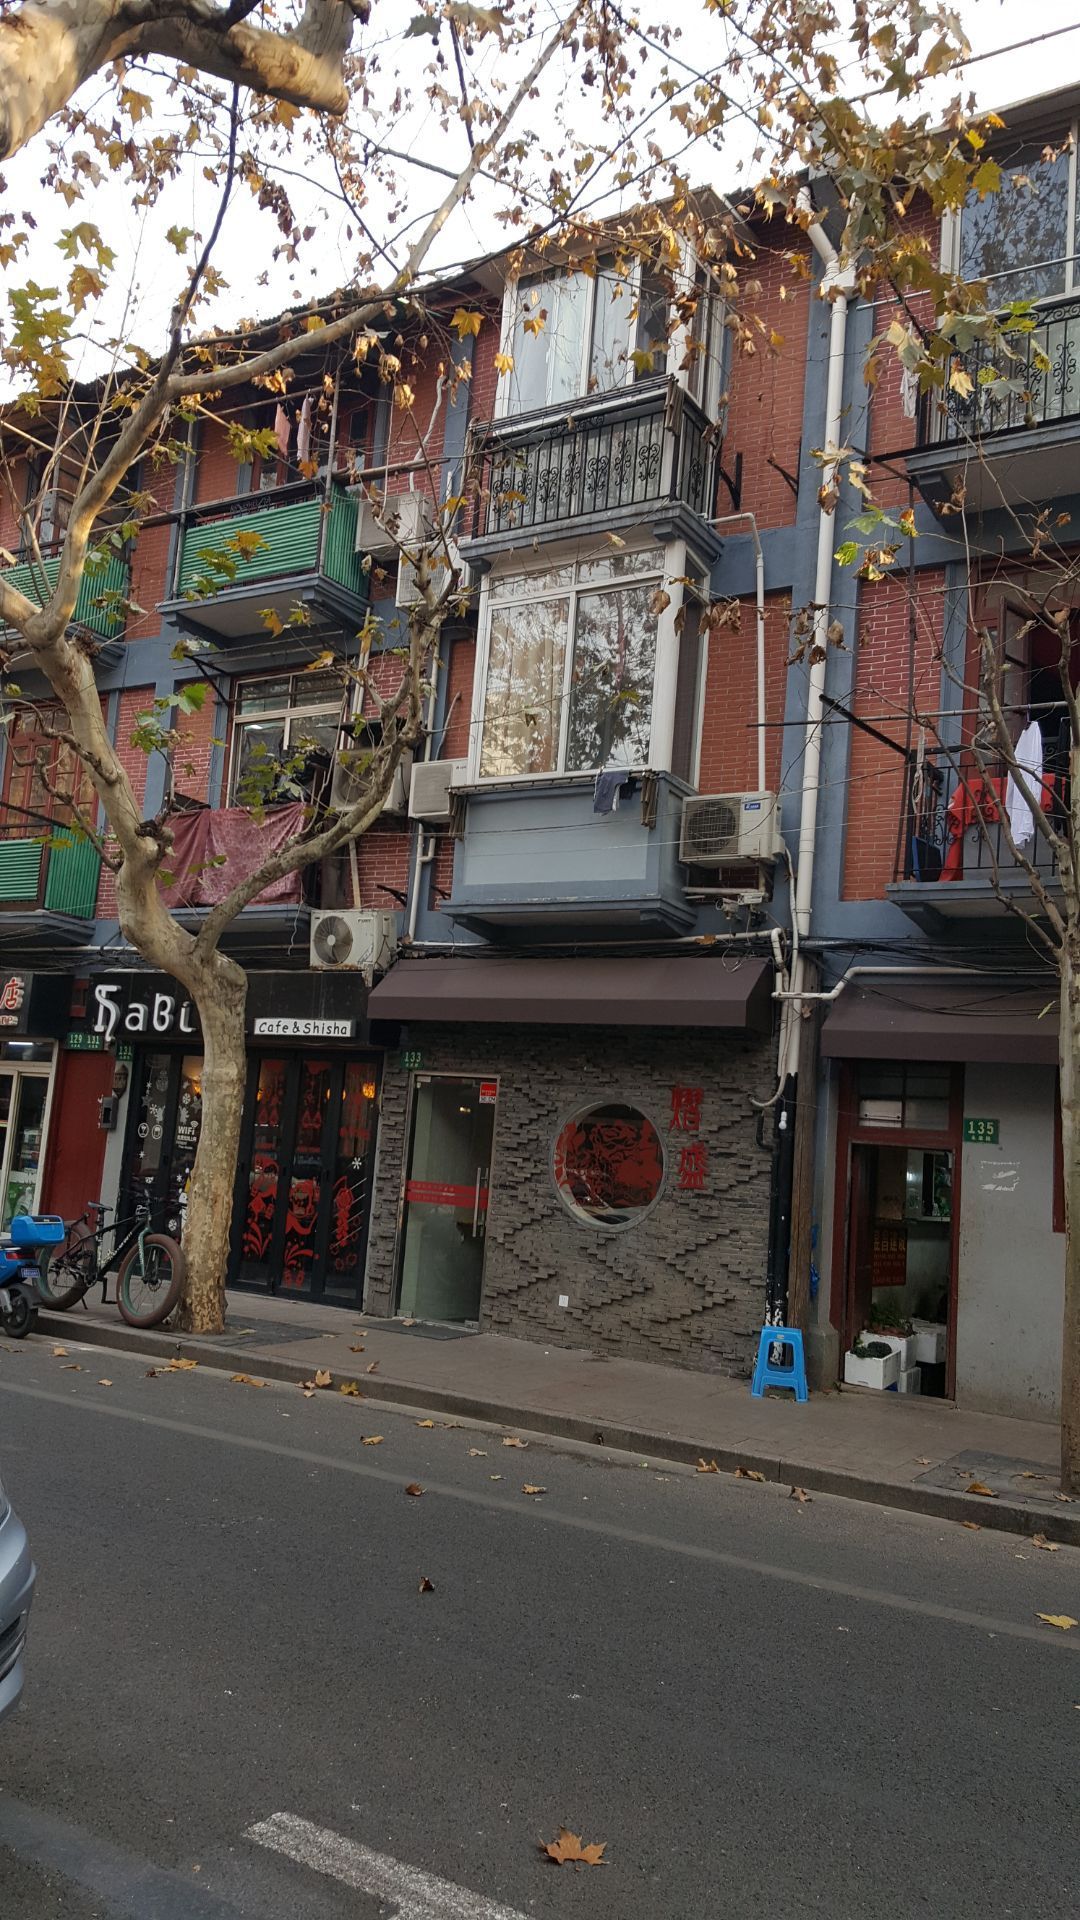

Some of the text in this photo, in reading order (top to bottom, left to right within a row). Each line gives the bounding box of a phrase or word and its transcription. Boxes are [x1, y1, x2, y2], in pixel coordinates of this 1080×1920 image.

[0, 977, 20, 1009] 店
[69, 1034, 83, 1044] 129
[87, 1035, 100, 1045] 131
[118, 1046, 133, 1056] 131
[404, 1051, 422, 1063] 133
[967, 1121, 994, 1135] 135
